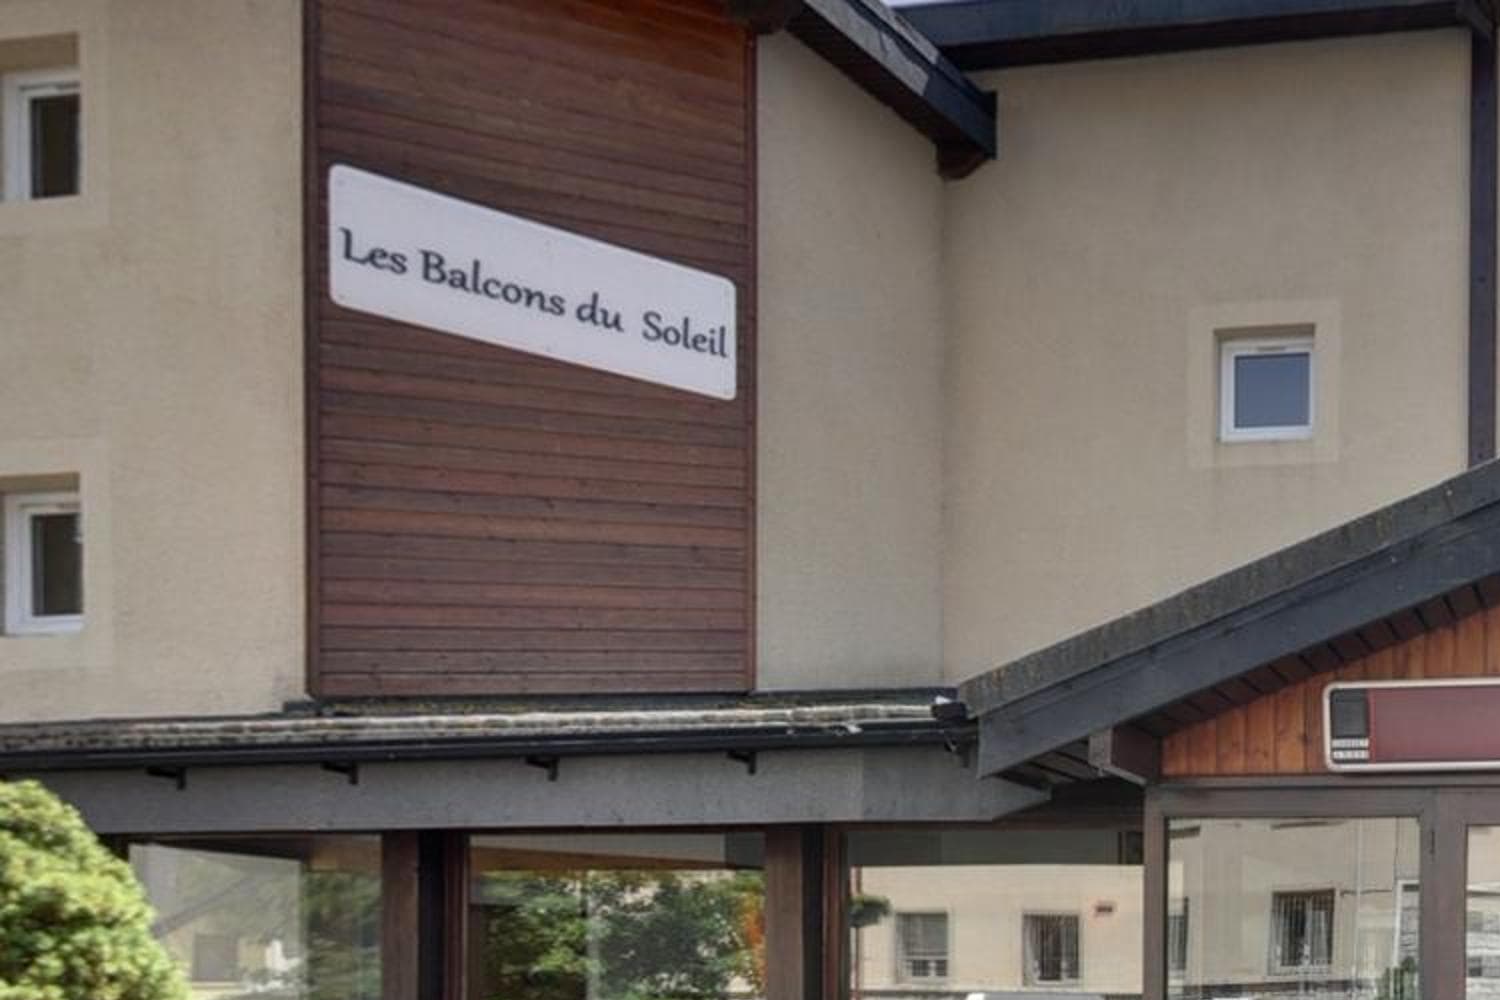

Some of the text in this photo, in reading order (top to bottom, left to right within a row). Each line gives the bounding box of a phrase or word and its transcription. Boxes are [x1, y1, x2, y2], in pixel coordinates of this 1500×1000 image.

[339, 227, 728, 359] Les Balcons du Soleil
